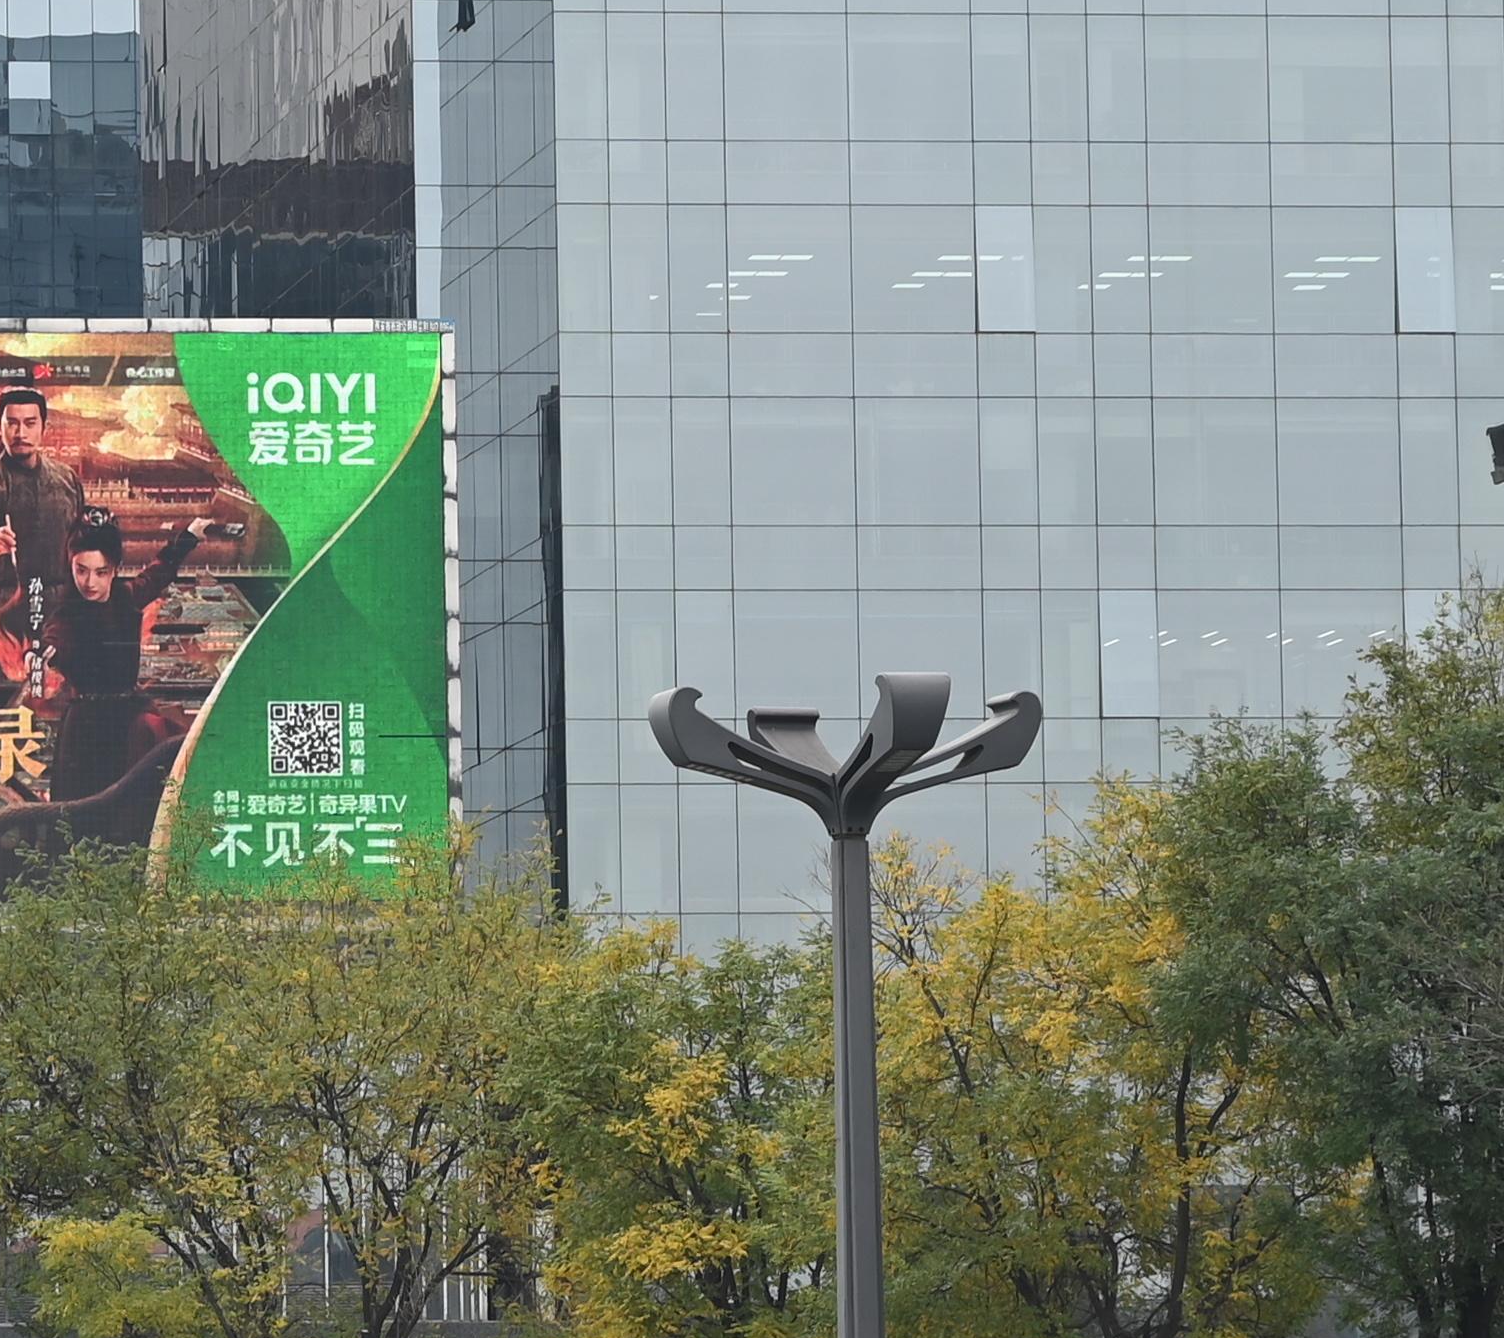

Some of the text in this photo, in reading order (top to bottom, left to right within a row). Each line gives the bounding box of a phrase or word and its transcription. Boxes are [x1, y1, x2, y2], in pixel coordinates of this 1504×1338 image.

[246, 372, 376, 413] iQIYI
[248, 420, 377, 466] 爱奇艺
[28, 576, 45, 631] 孙雪宁
[348, 702, 366, 776] 扫码观看
[247, 793, 307, 816] 爱奇艺
